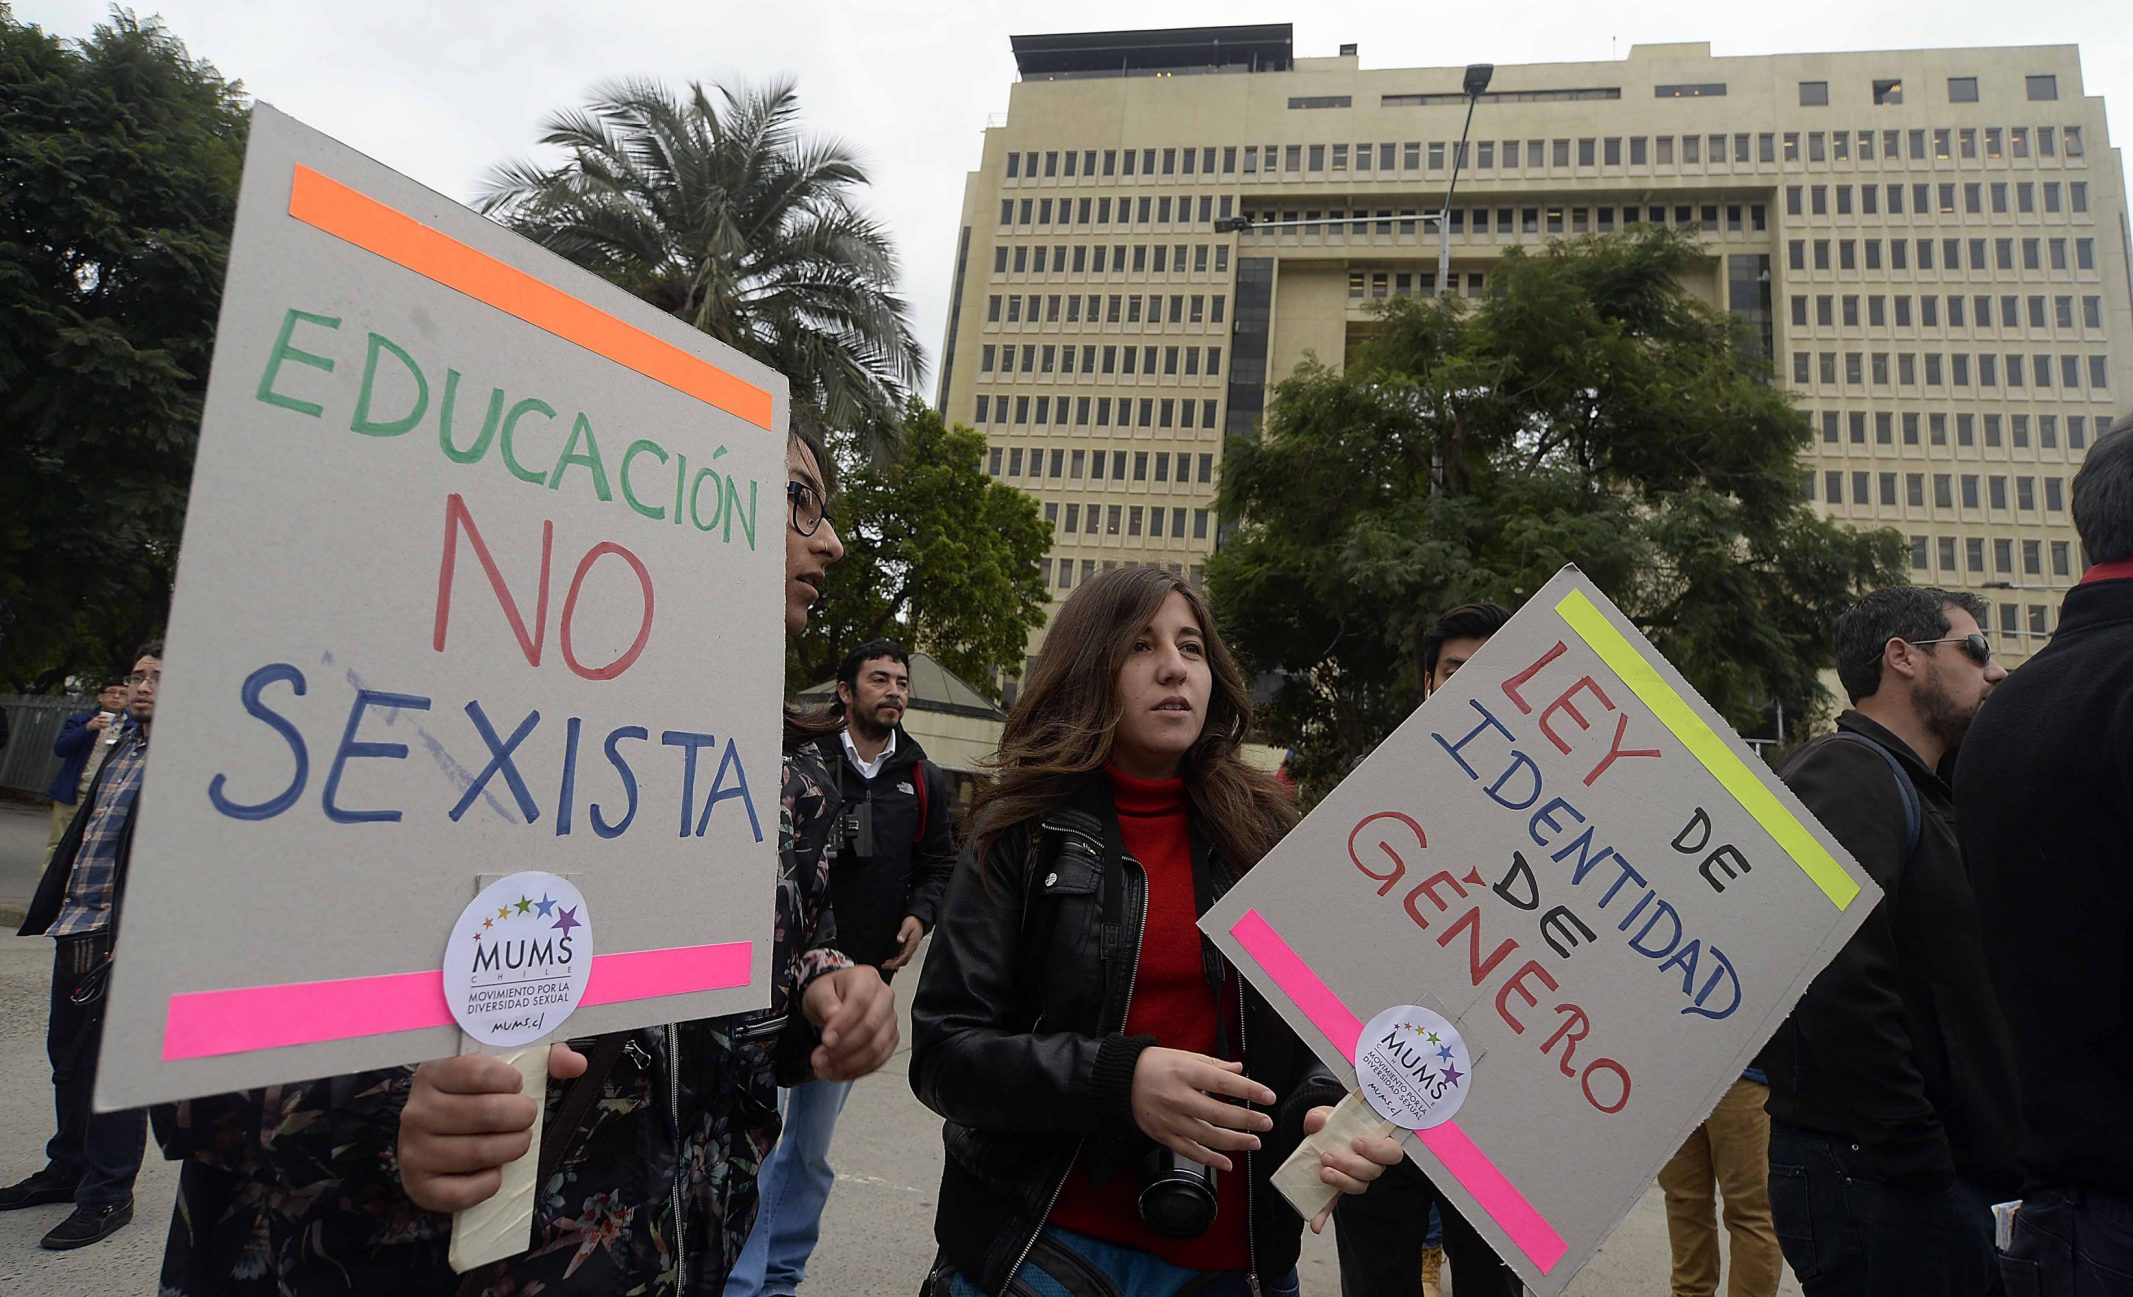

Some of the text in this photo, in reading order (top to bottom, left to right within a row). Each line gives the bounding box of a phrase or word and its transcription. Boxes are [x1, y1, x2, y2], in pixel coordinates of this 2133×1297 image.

[256, 308, 758, 551] EDUCACIÓN
[434, 493, 654, 680] NO
[208, 662, 764, 843] SEXISTA
[1500, 640, 1752, 893] LEY DE
[1431, 699, 1742, 1020] IDENTIDAD
[1492, 851, 1597, 958] DE
[467, 993, 569, 1015] DIVERSIDAD SEXUAL
[468, 982, 570, 1003] MOVIMIENTO POR LA
[472, 936, 573, 973] MUMS
[1347, 811, 1632, 1114] GÉNERO
[1362, 1056, 1423, 1121] DIVERSIDAD SEXUAL
[1367, 1051, 1427, 1116] MOVIMIENTO POR LA
[1381, 1031, 1448, 1100] MUMS
